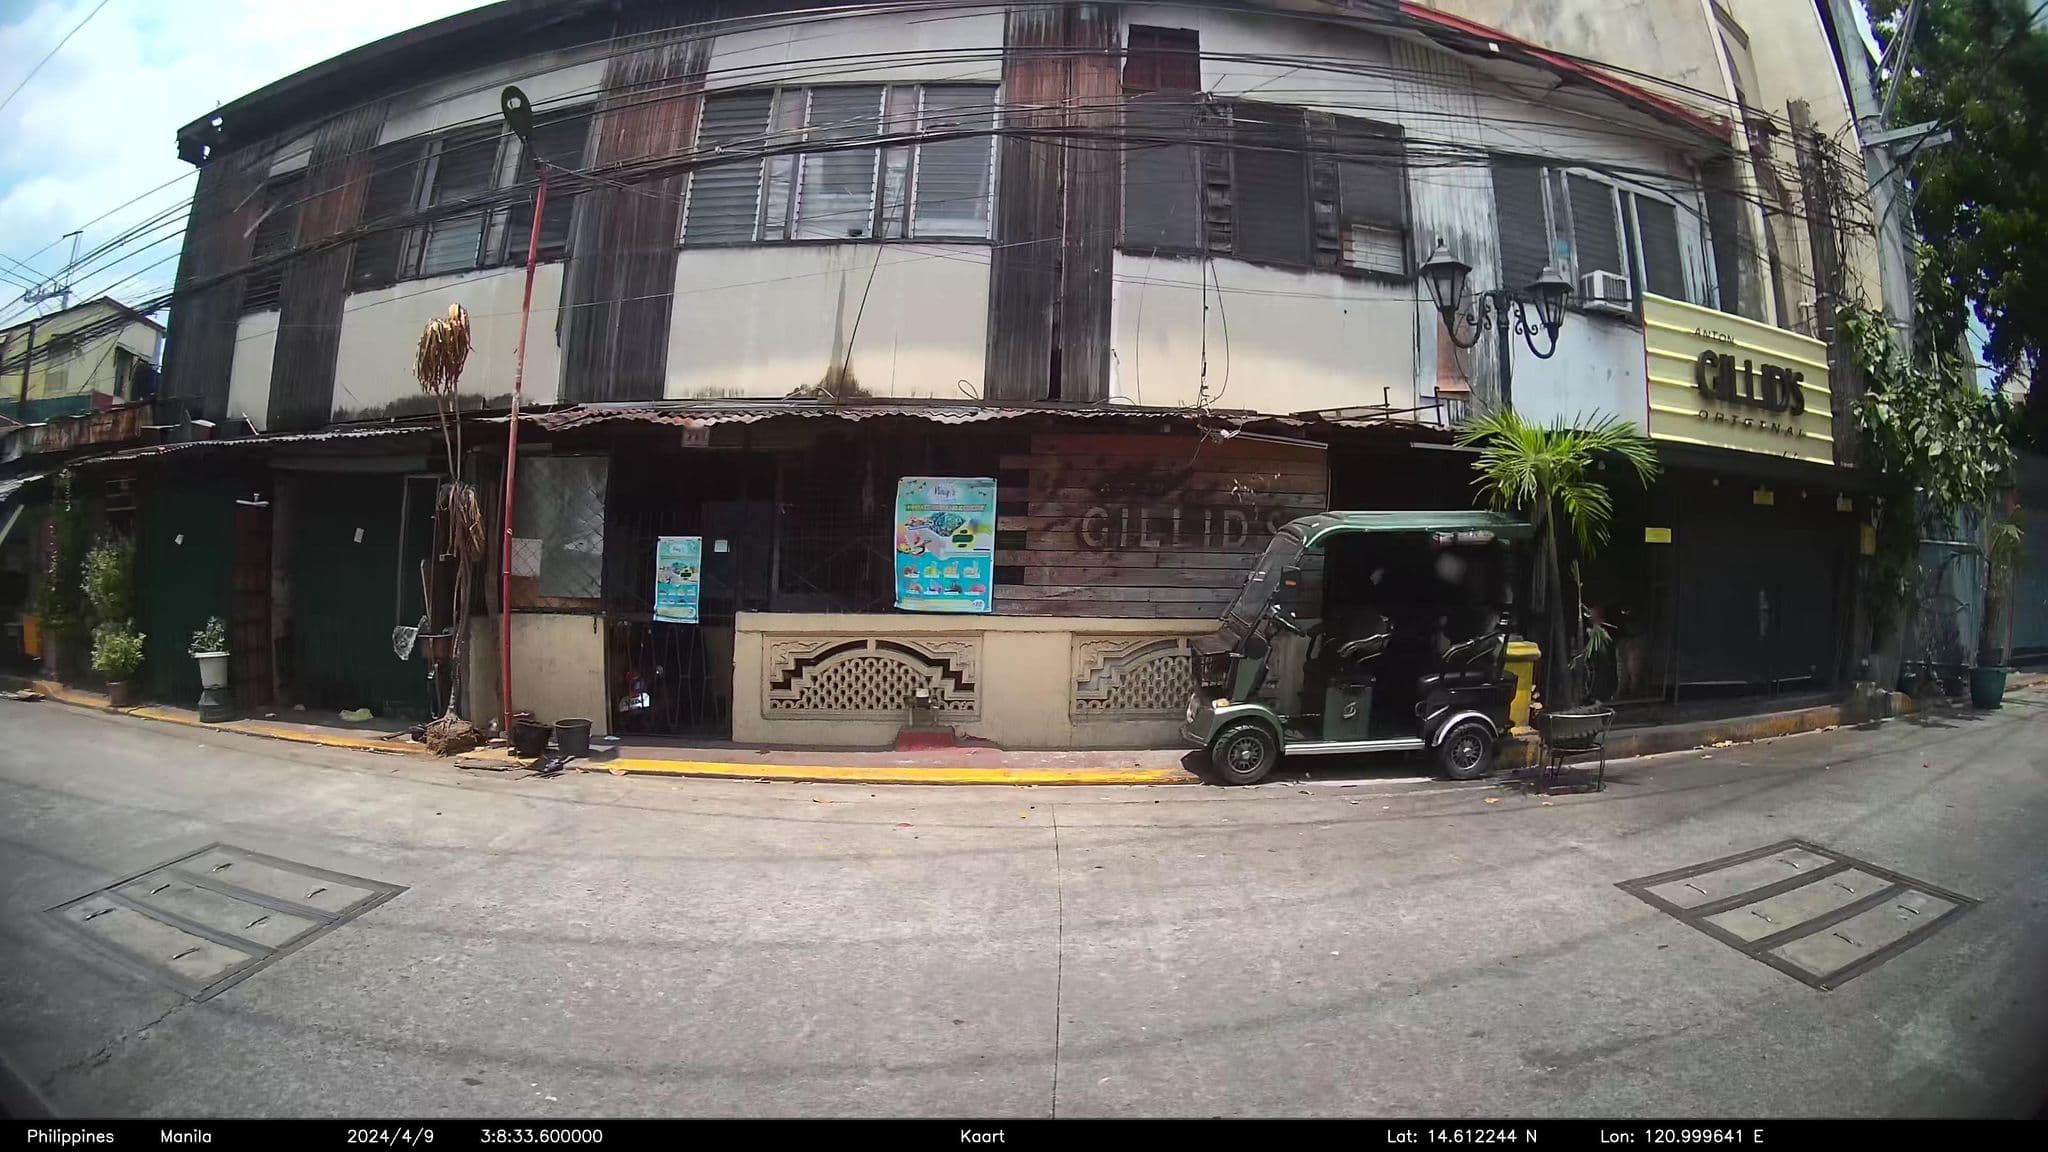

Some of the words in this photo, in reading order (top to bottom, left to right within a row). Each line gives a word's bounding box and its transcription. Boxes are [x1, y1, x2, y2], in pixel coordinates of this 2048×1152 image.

[1694, 328, 1734, 344] ANTON
[1696, 349, 1805, 416] GILLID'S
[1697, 409, 1807, 438] ORIGINAL
